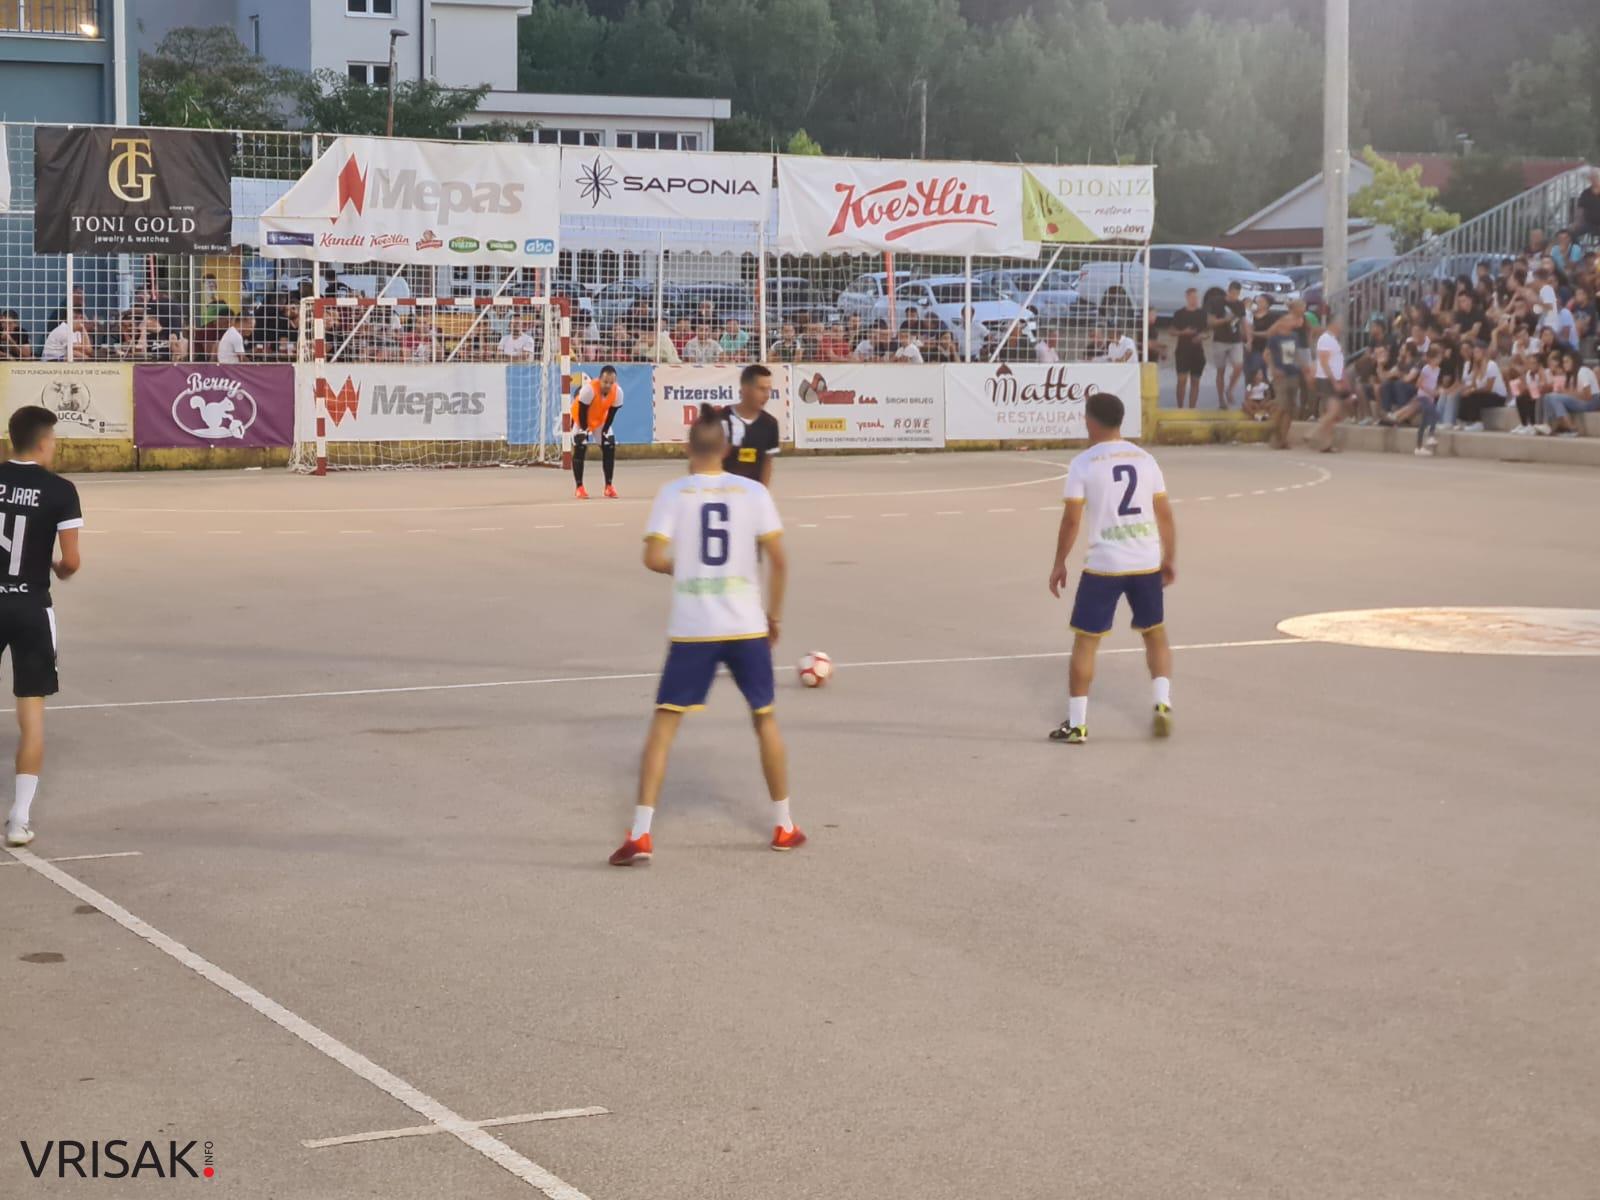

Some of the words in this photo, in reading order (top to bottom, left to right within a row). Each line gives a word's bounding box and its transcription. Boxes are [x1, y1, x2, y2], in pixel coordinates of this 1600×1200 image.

[623, 176, 760, 196] SAPONIA
[1058, 178, 1151, 197] DIONIZ
[369, 168, 525, 226] Mepas
[828, 176, 996, 238] Koestlin
[72, 216, 125, 232] TONI
[134, 216, 196, 234] GOLD
[1103, 225, 1122, 235] KOD
[94, 234, 125, 244] jewelry
[127, 235, 133, 243] &
[135, 235, 170, 244] watches
[319, 233, 366, 247] Kandit
[369, 233, 409, 248] Koestlin
[526, 240, 553, 254] abc
[186, 372, 242, 398] Berny
[663, 385, 733, 400] Frizerski
[370, 385, 487, 424] Mepas
[57, 412, 83, 422] UCCA
[894, 418, 931, 429] ROWE
[996, 411, 1087, 424] RESTAURA
[7, 487, 41, 507] JARE
[1112, 464, 1142, 517] 2
[700, 502, 729, 567] 6
